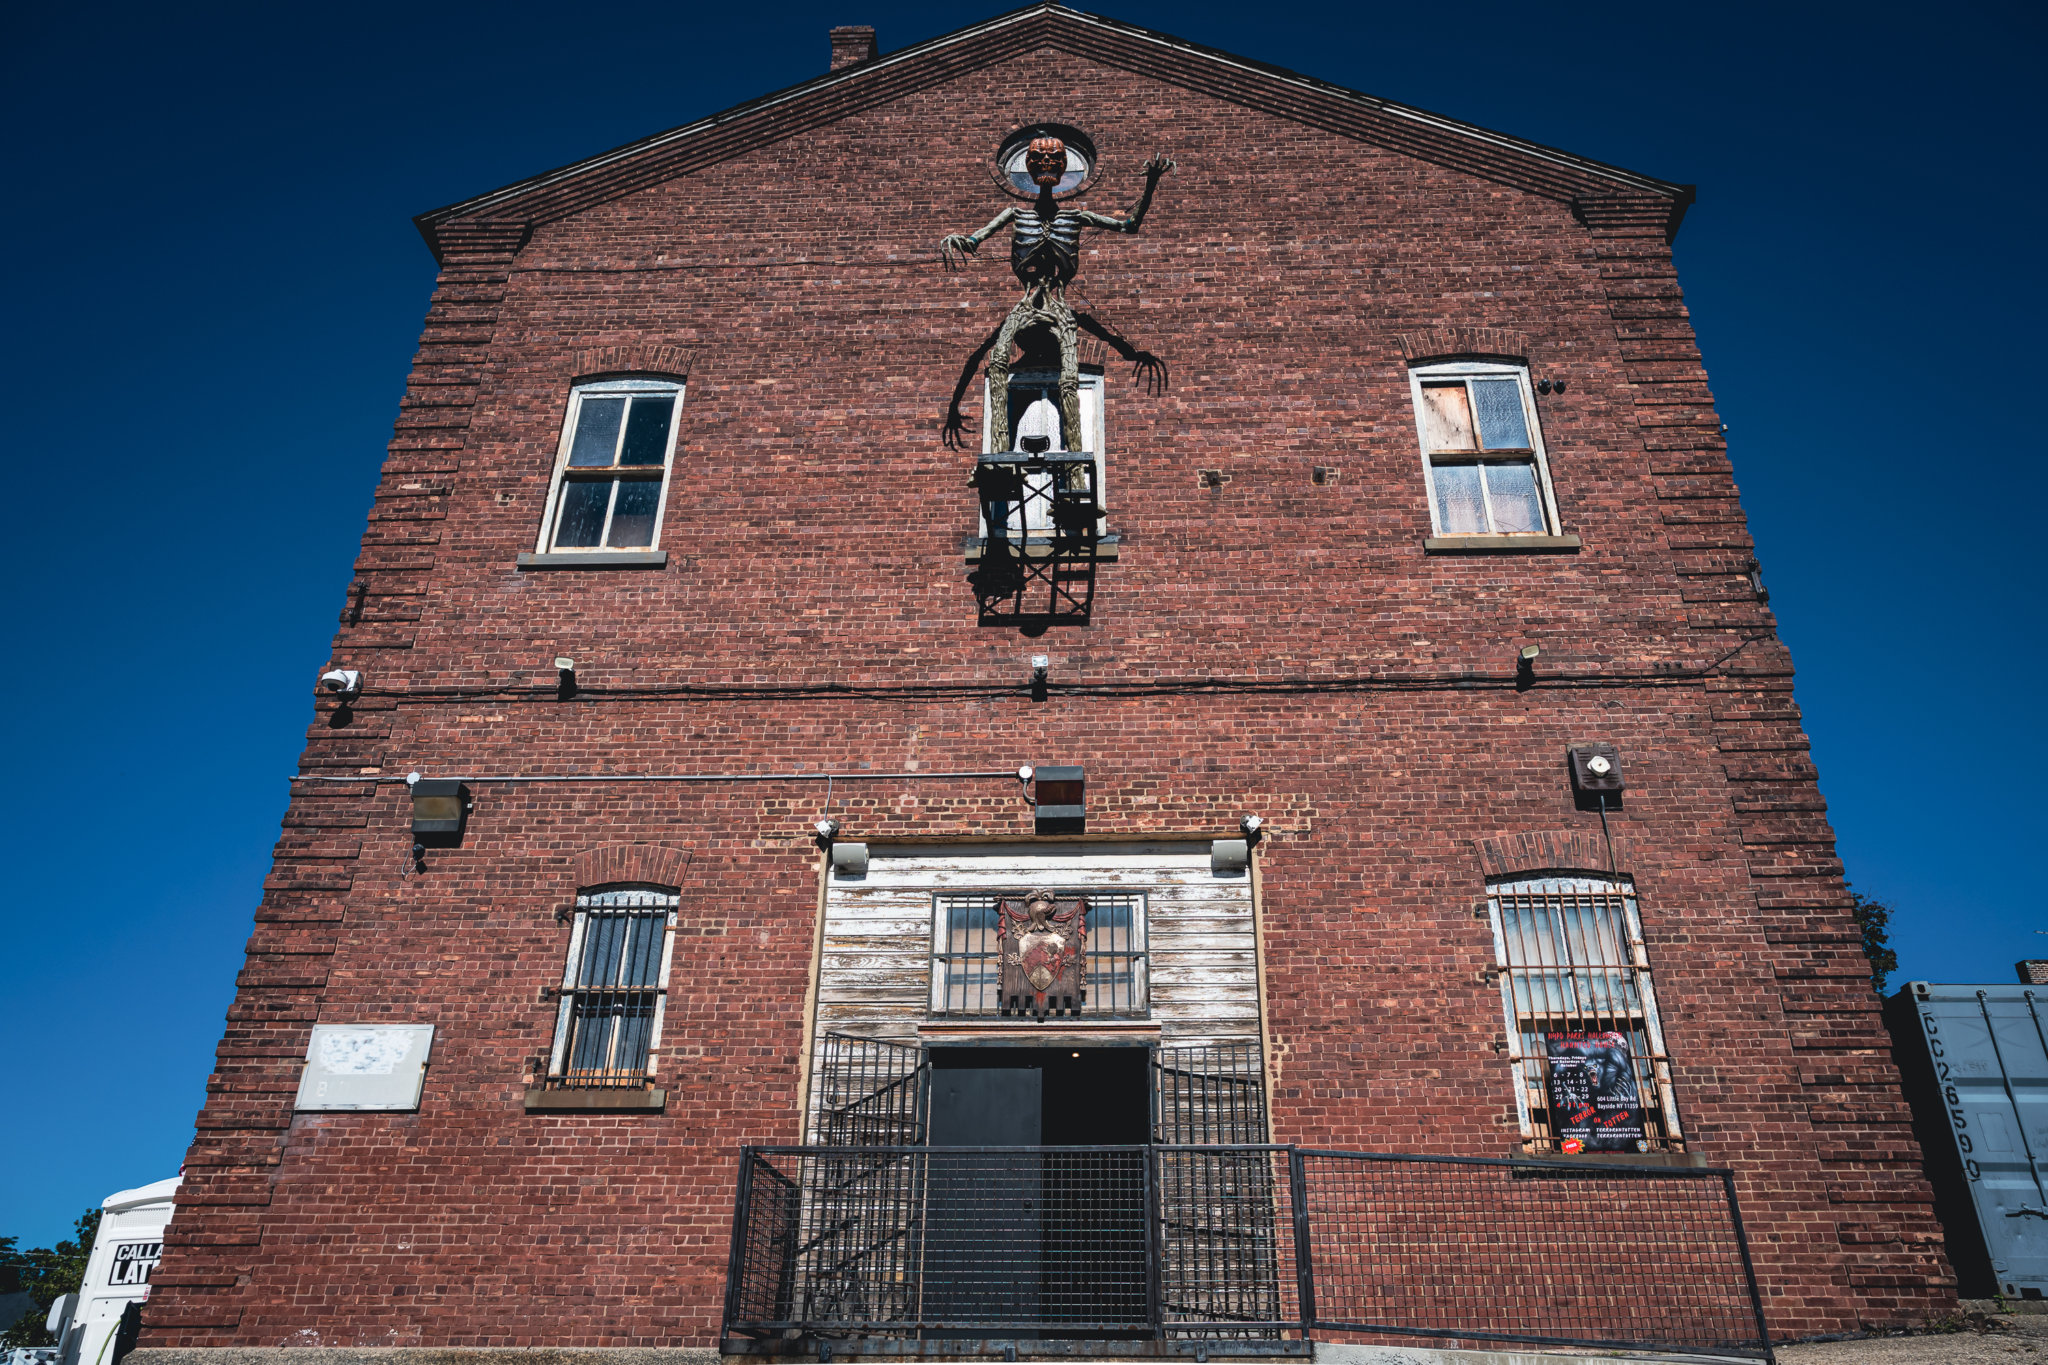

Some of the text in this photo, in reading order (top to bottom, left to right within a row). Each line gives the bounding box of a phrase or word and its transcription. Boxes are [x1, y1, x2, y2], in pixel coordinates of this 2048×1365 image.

[1548, 1032, 1563, 1040] NYPD
[1570, 1106, 1596, 1125] TERROR
[1603, 1111, 1629, 1128] TOTTEN
